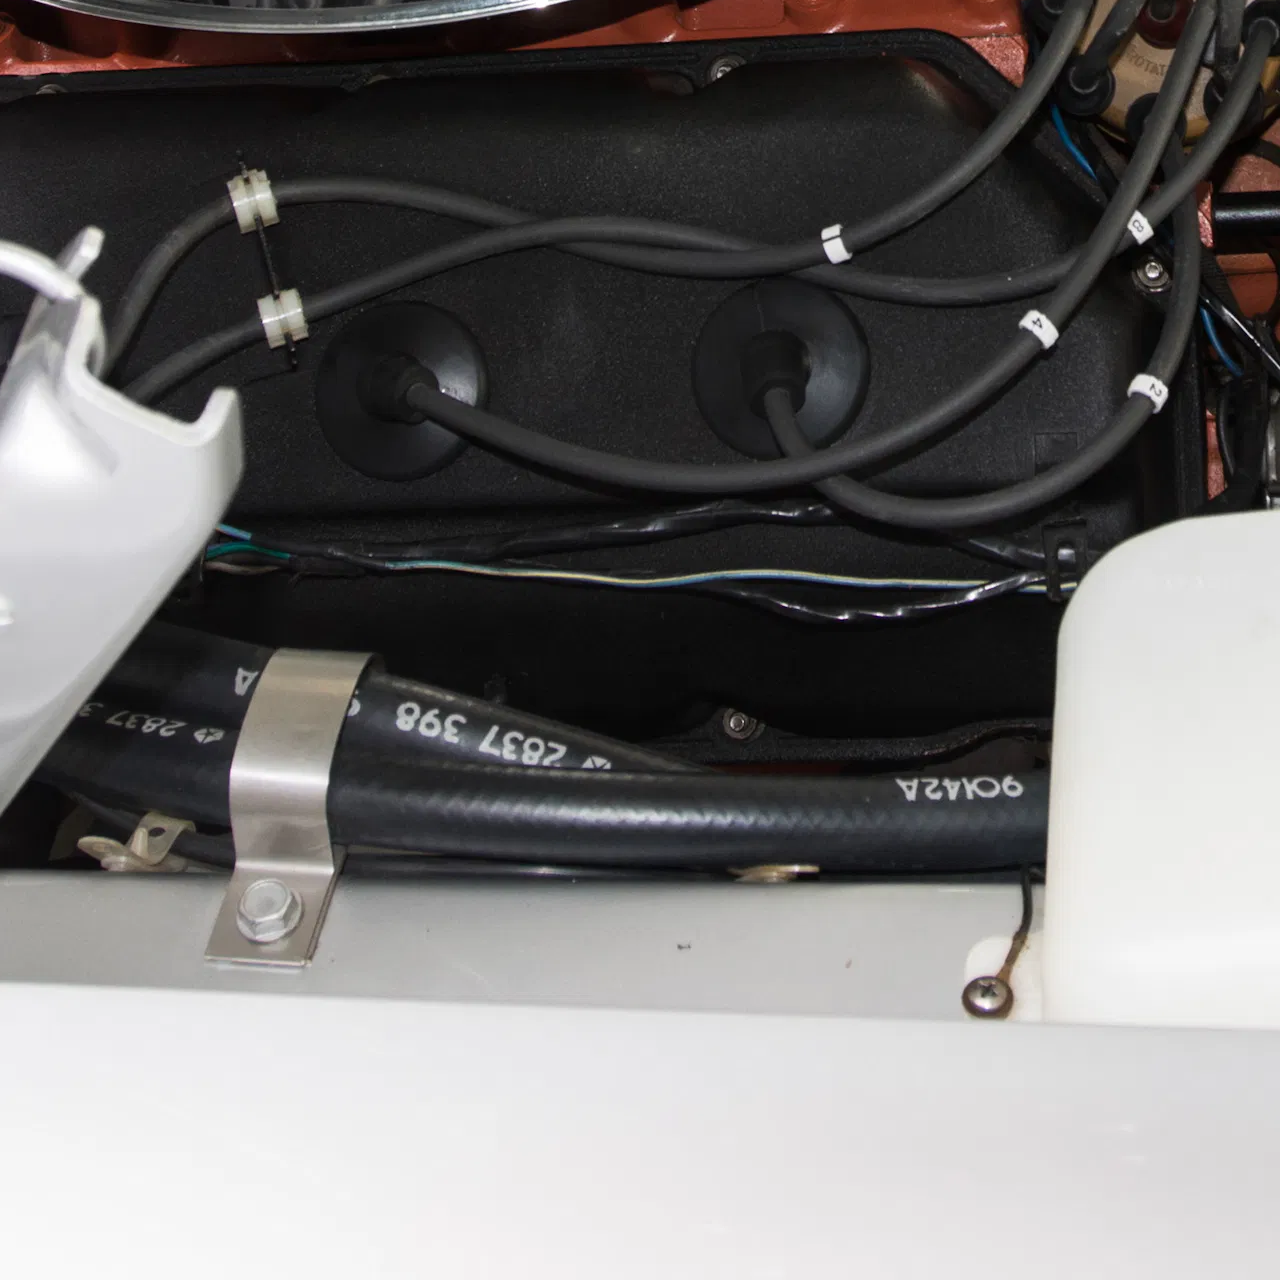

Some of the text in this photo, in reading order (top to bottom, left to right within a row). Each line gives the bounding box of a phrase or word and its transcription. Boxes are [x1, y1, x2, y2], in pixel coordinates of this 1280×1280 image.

[1132, 220, 1144, 233] 8
[1032, 316, 1044, 329] 4
[1150, 383, 1162, 397] 2
[395, 701, 568, 768] 2837 398
[894, 775, 1024, 802] 90142A
